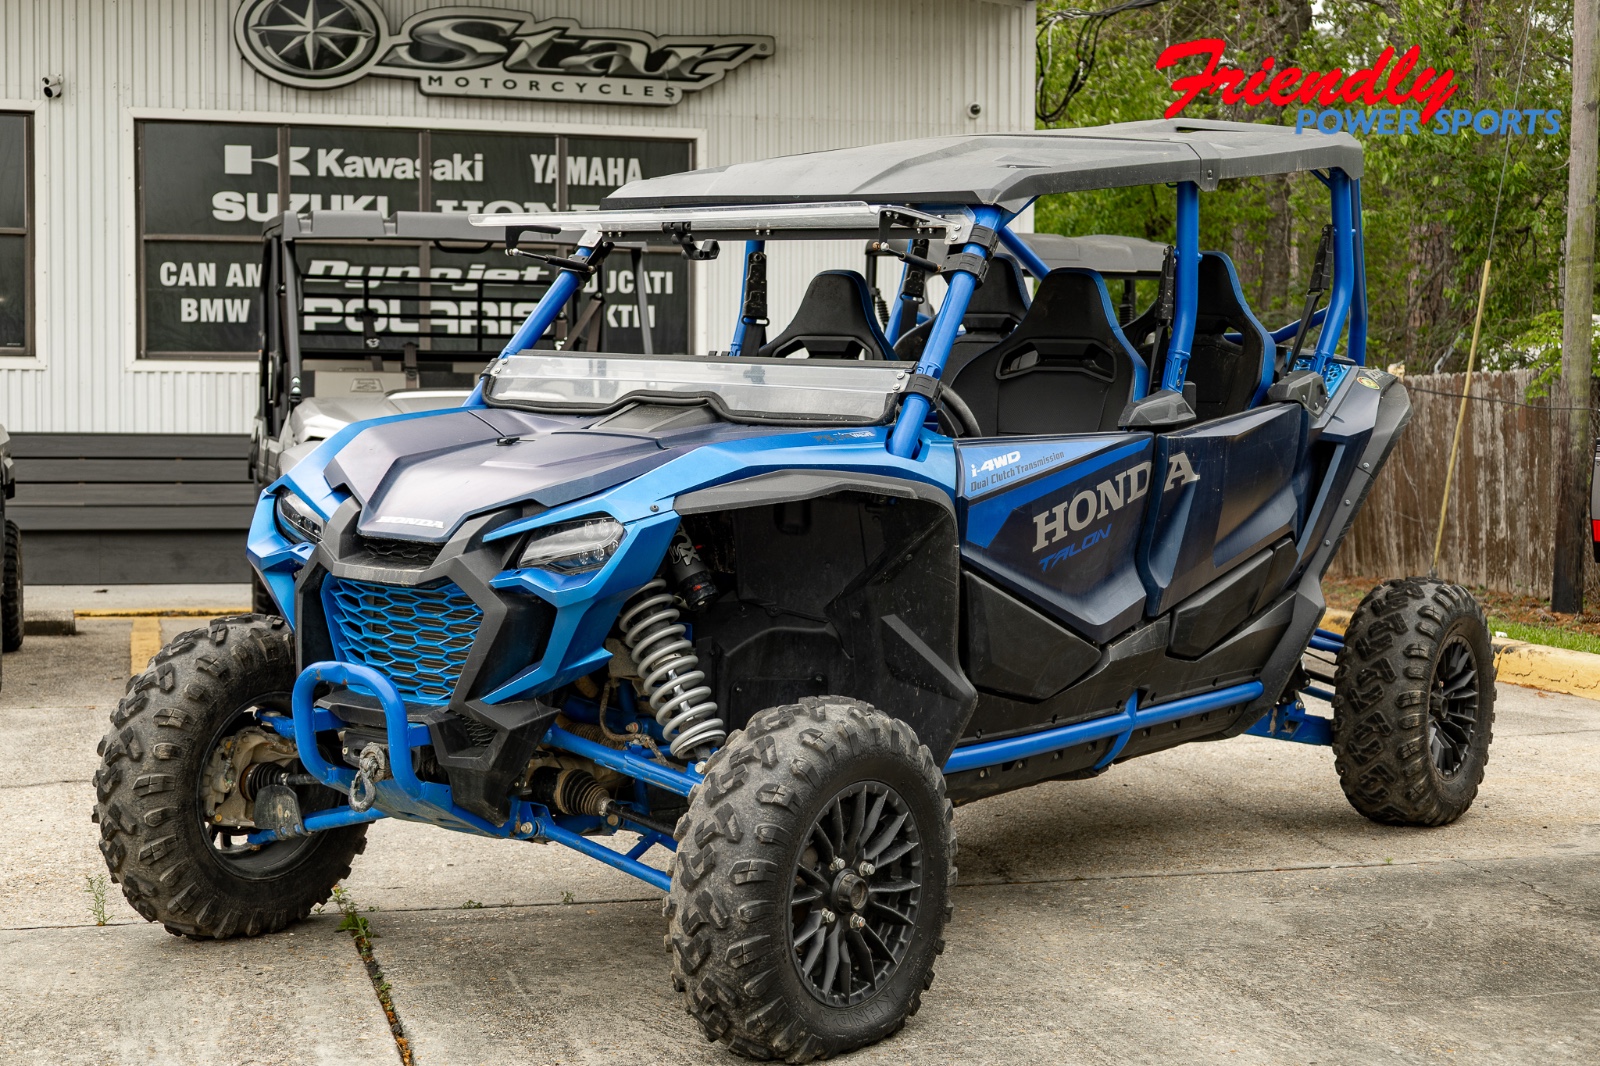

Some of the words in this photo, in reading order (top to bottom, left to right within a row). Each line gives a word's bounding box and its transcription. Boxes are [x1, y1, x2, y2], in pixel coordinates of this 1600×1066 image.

[376, 16, 757, 81] Star
[428, 75, 676, 99] MOTORCYCLES
[530, 153, 643, 187] YAMAHA
[160, 261, 216, 287] CAN
[583, 269, 673, 294] DUCTI
[180, 297, 251, 323] BMW
[970, 450, 1022, 478] i-4WD
[970, 477, 989, 492] Dual
[991, 467, 1015, 484] Clutch
[1015, 451, 1065, 475] Transmission
[1032, 451, 1201, 553] HONDA
[1039, 523, 1113, 573] TALON
